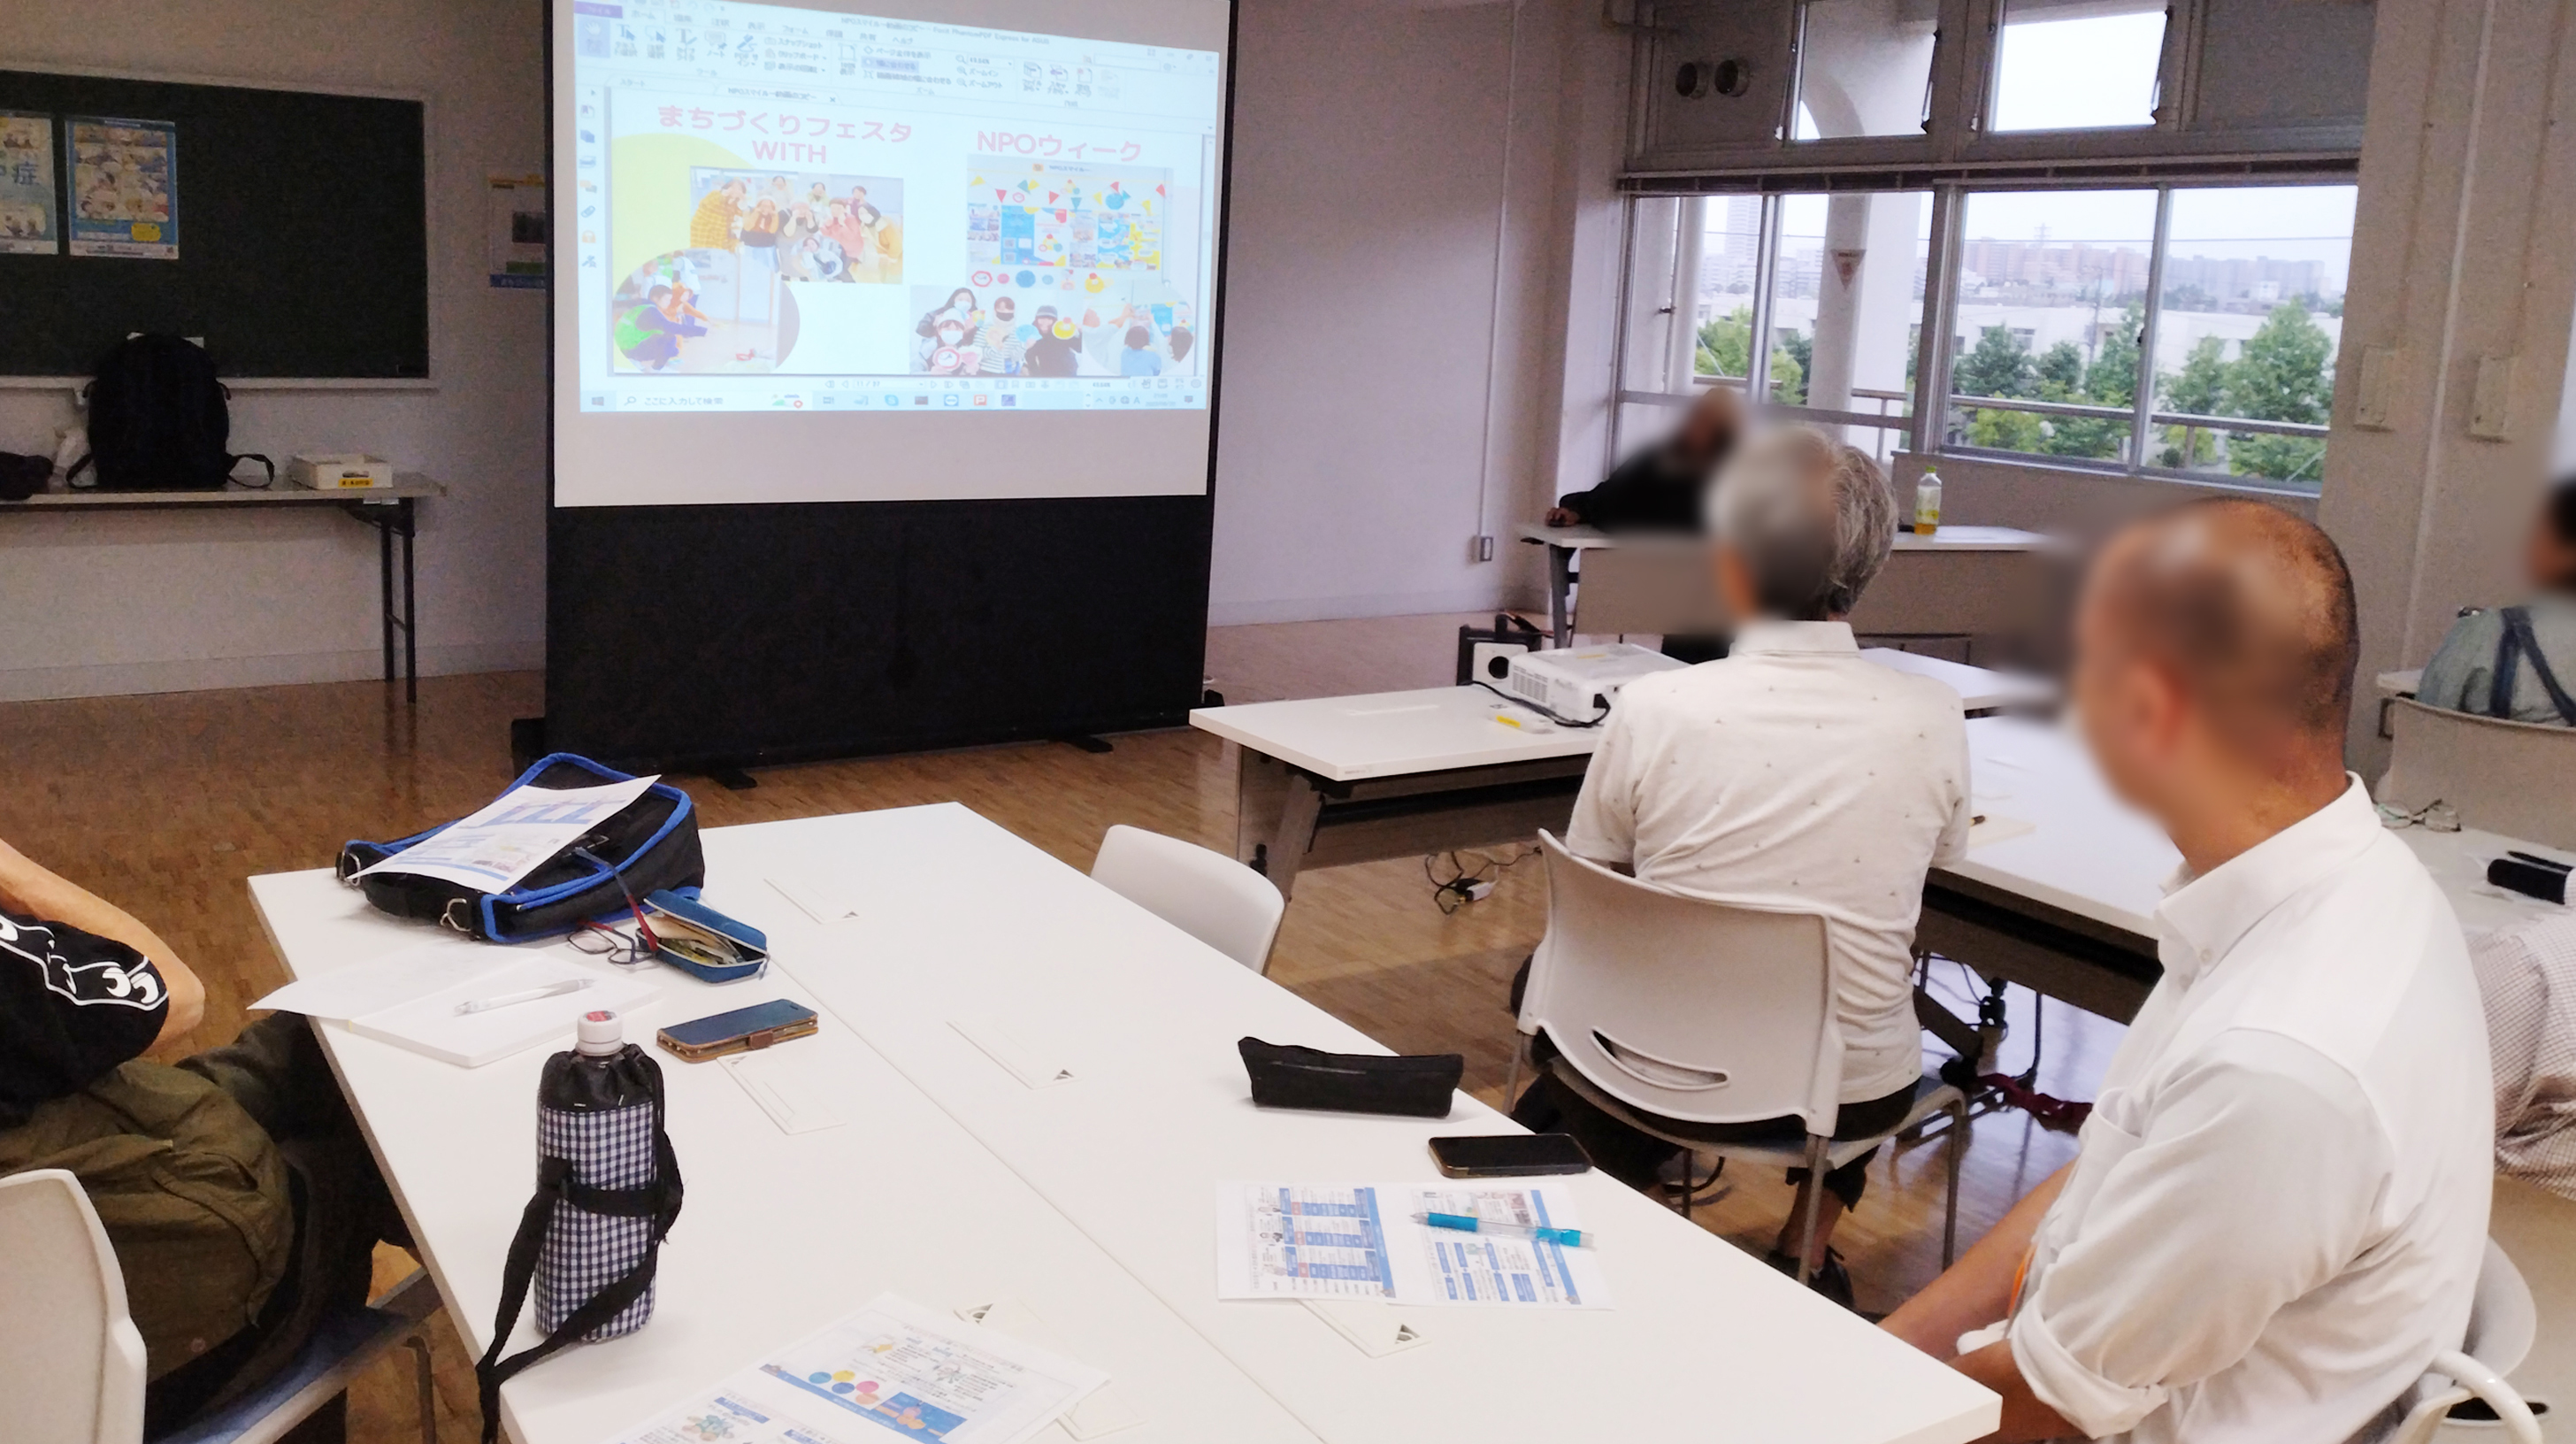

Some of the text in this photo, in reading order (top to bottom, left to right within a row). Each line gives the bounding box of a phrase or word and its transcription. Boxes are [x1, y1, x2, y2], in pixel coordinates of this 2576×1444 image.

[657, 104, 912, 143] まちづくりフェスタ
[751, 140, 827, 165] WITH
[977, 130, 1141, 162] NPOウィーク
[644, 396, 724, 407] ここに入力して検索
